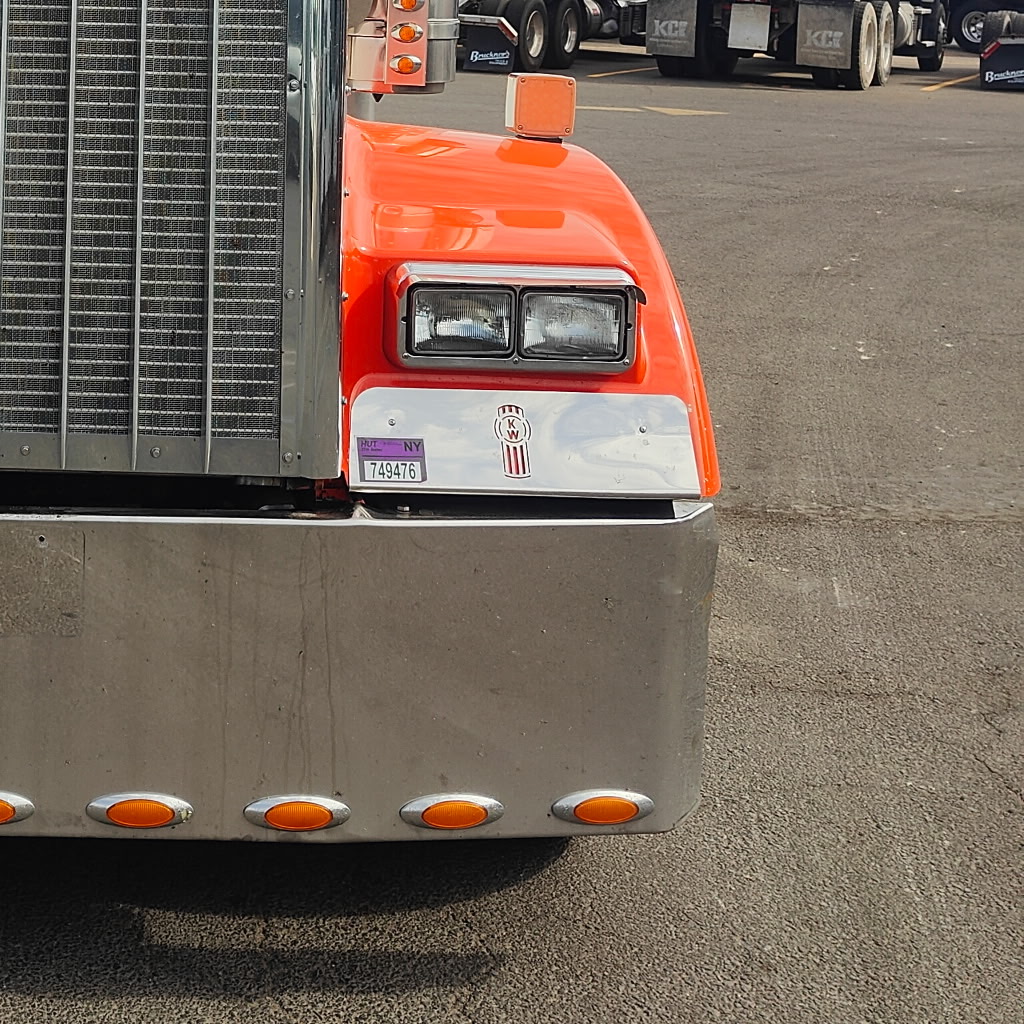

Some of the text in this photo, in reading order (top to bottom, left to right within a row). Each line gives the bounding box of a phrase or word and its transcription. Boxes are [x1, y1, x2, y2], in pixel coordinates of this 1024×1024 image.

[360, 440, 378, 448] HUT
[403, 441, 422, 452] NY
[370, 462, 416, 479] 749476
